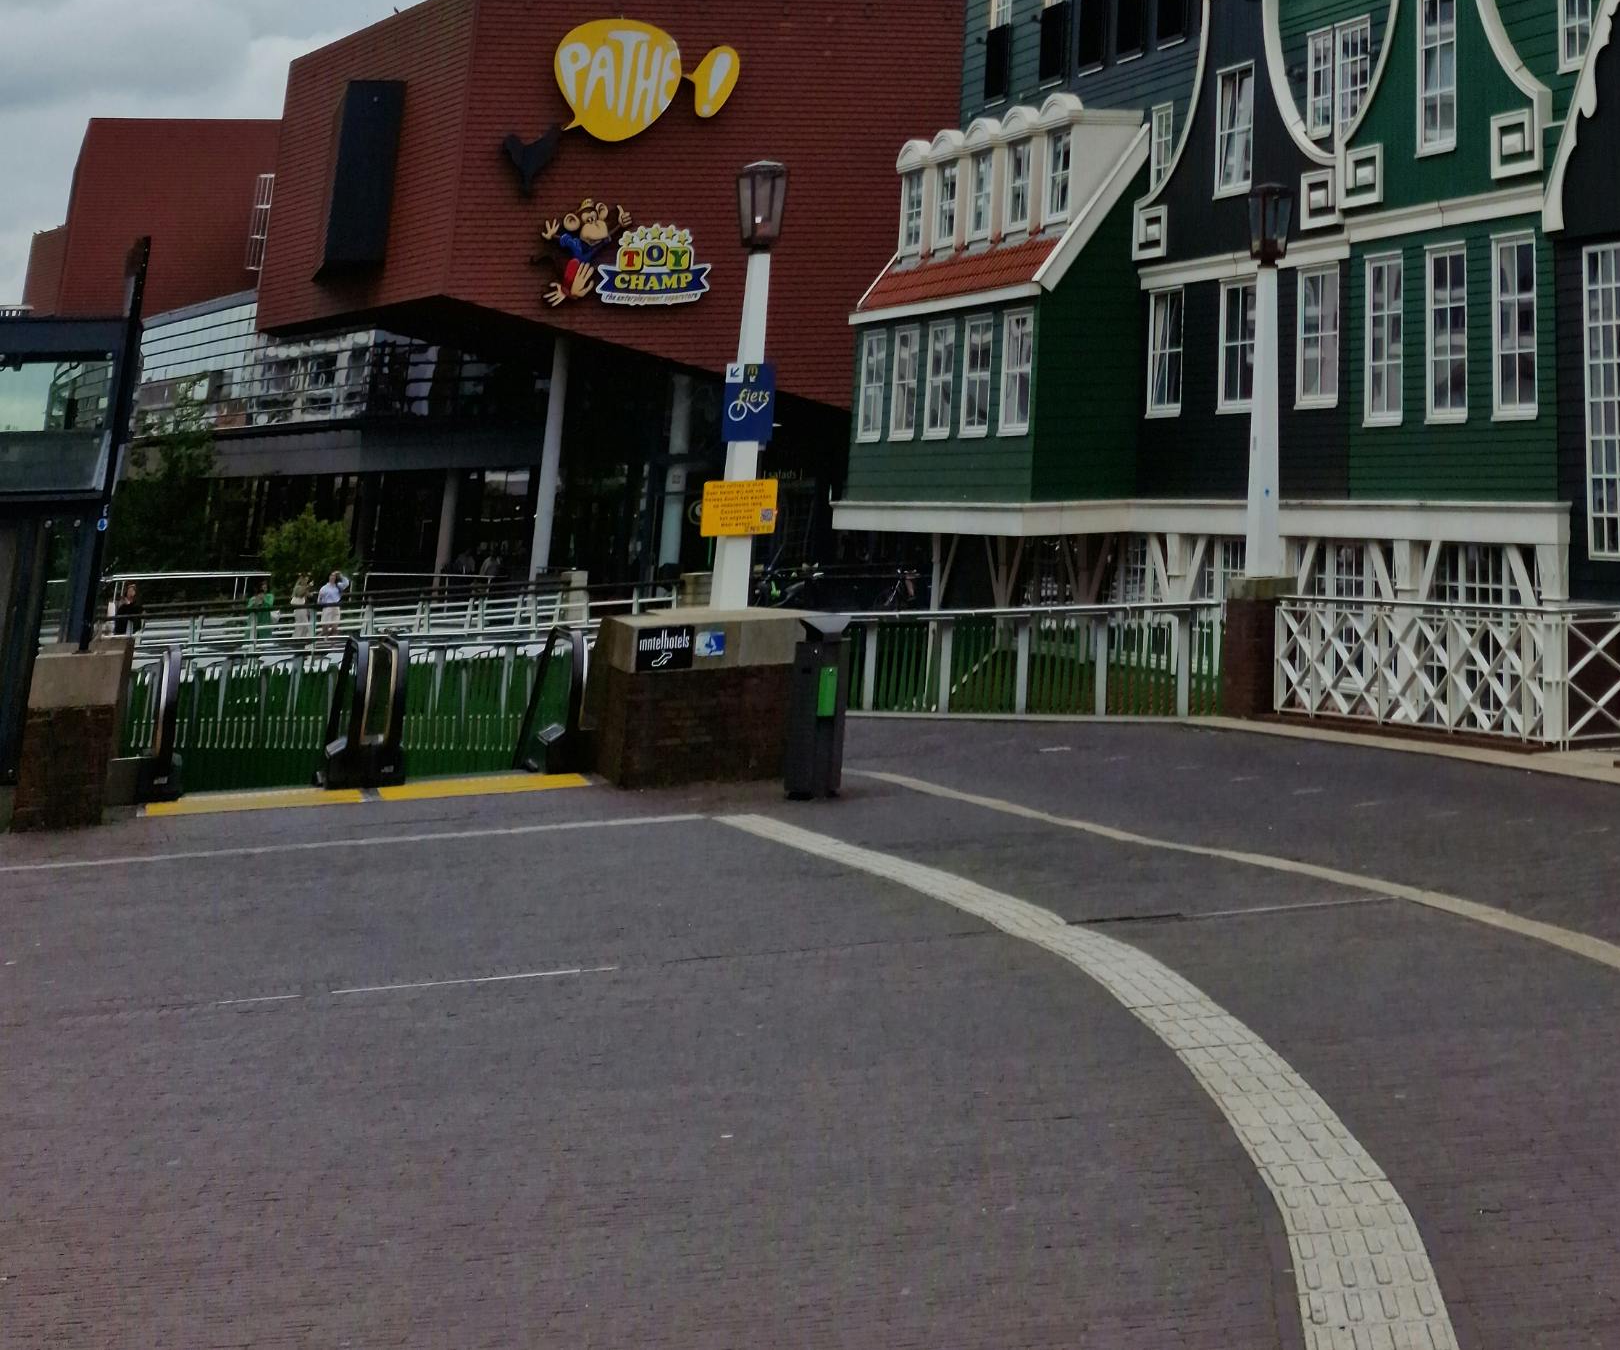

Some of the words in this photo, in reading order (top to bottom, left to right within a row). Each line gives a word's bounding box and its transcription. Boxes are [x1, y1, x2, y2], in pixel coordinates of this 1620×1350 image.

[623, 245, 688, 268] TOY
[614, 273, 693, 291] CHAMP
[737, 388, 770, 411] fiets
[639, 628, 690, 652] inntelhotels
